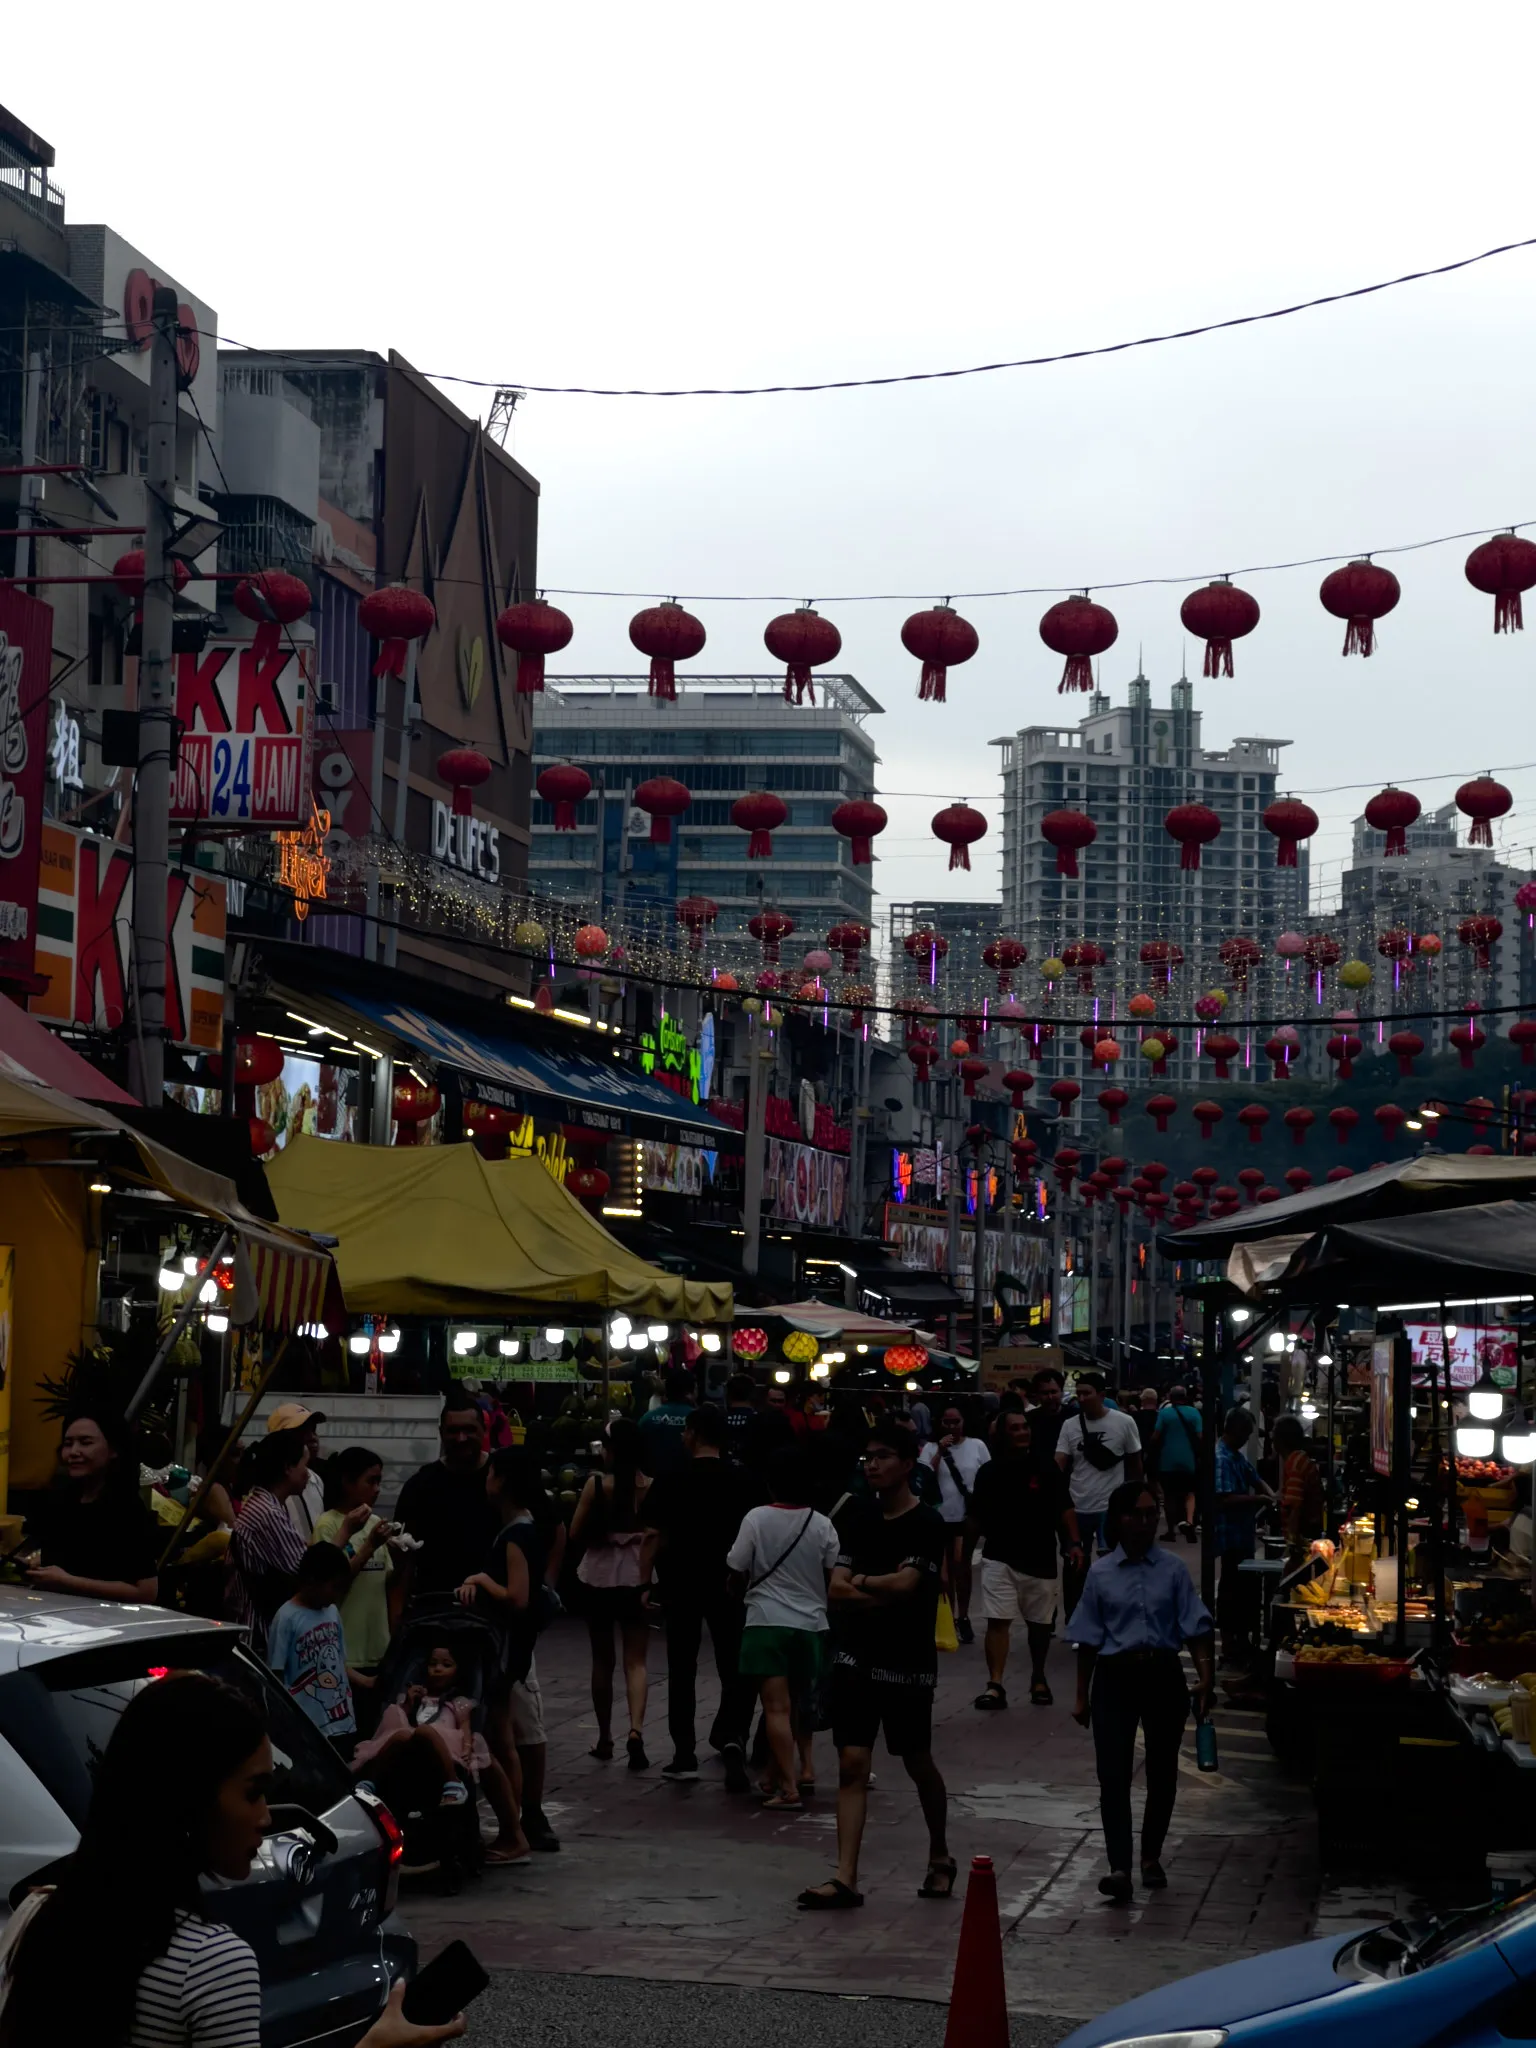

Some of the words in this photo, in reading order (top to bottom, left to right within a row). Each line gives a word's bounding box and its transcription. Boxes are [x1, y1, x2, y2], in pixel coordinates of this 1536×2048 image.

[176, 647, 296, 733] KK
[212, 738, 250, 816] 24
[254, 745, 297, 813] JAM
